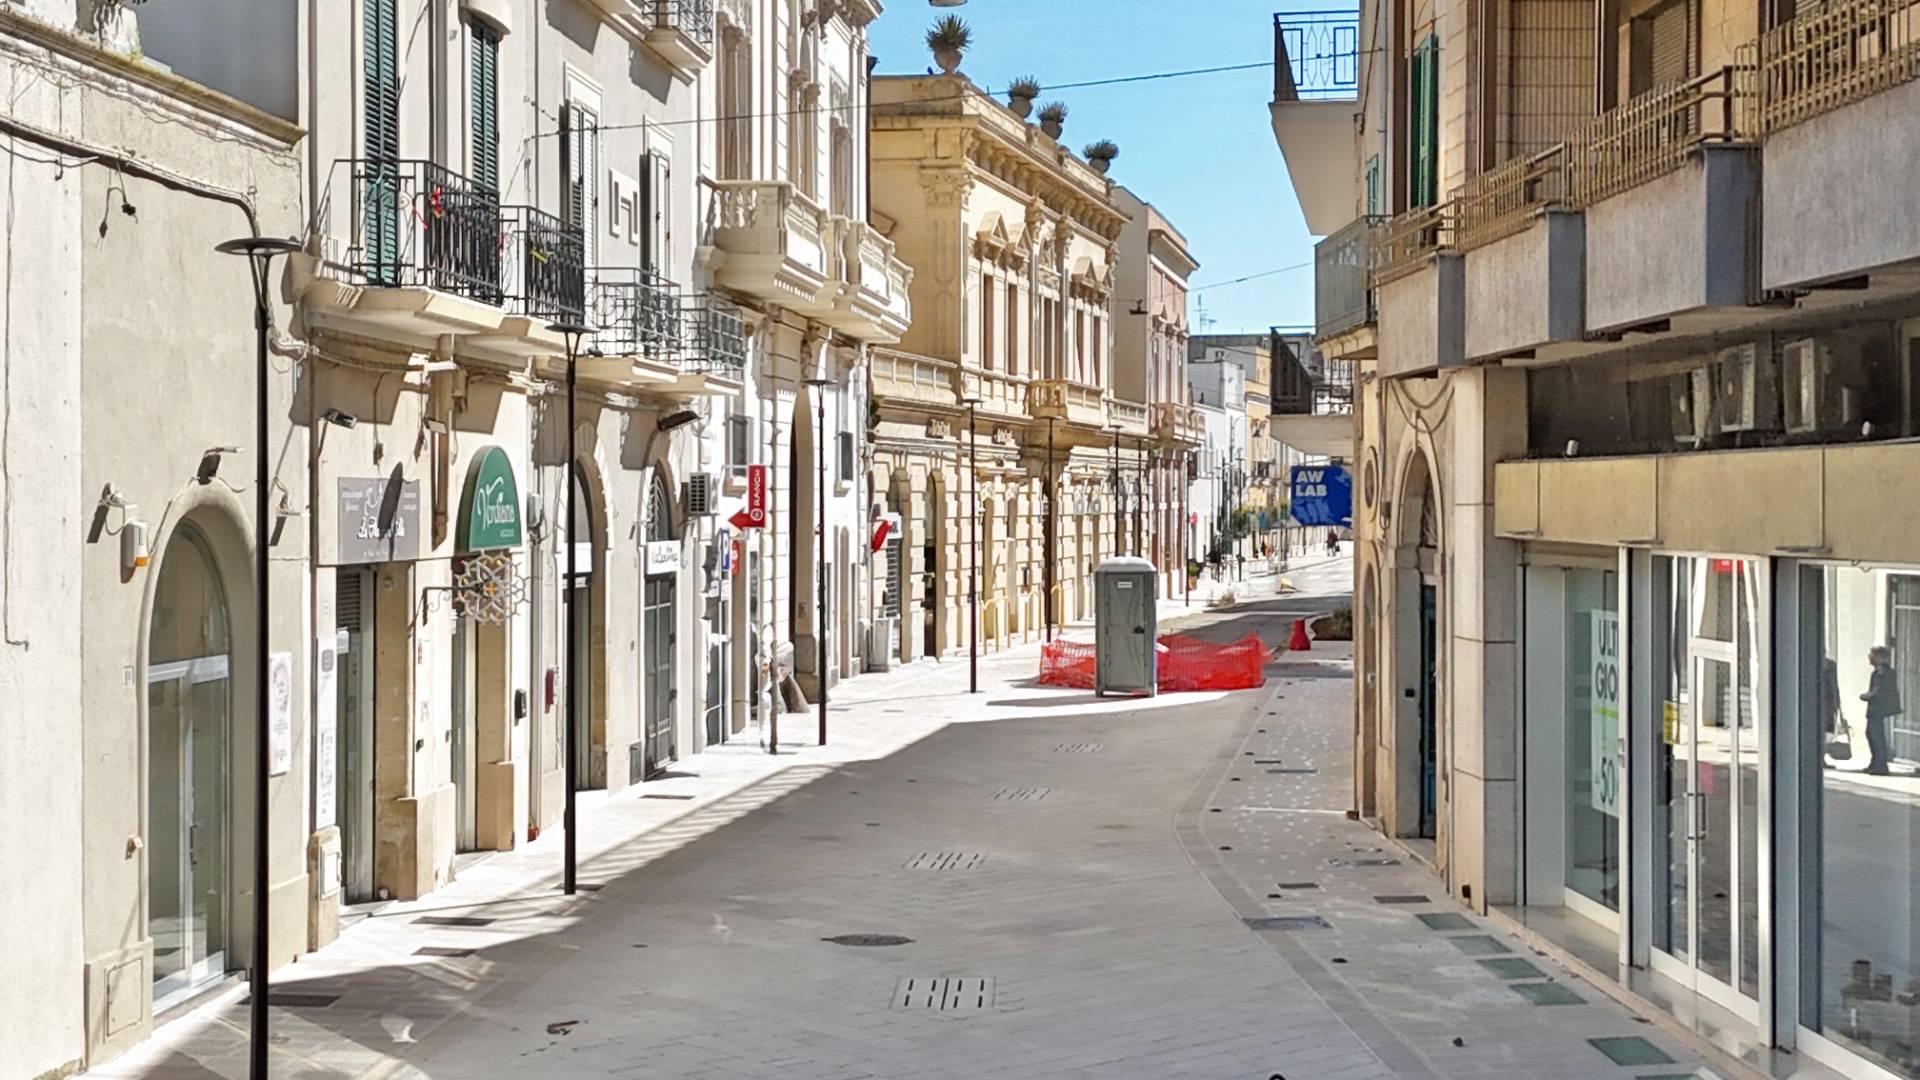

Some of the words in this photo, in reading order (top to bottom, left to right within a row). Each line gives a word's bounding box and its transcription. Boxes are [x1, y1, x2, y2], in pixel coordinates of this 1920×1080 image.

[1296, 470, 1325, 483] AW
[1295, 484, 1328, 497] LAB
[1595, 661, 1618, 702] GIO
